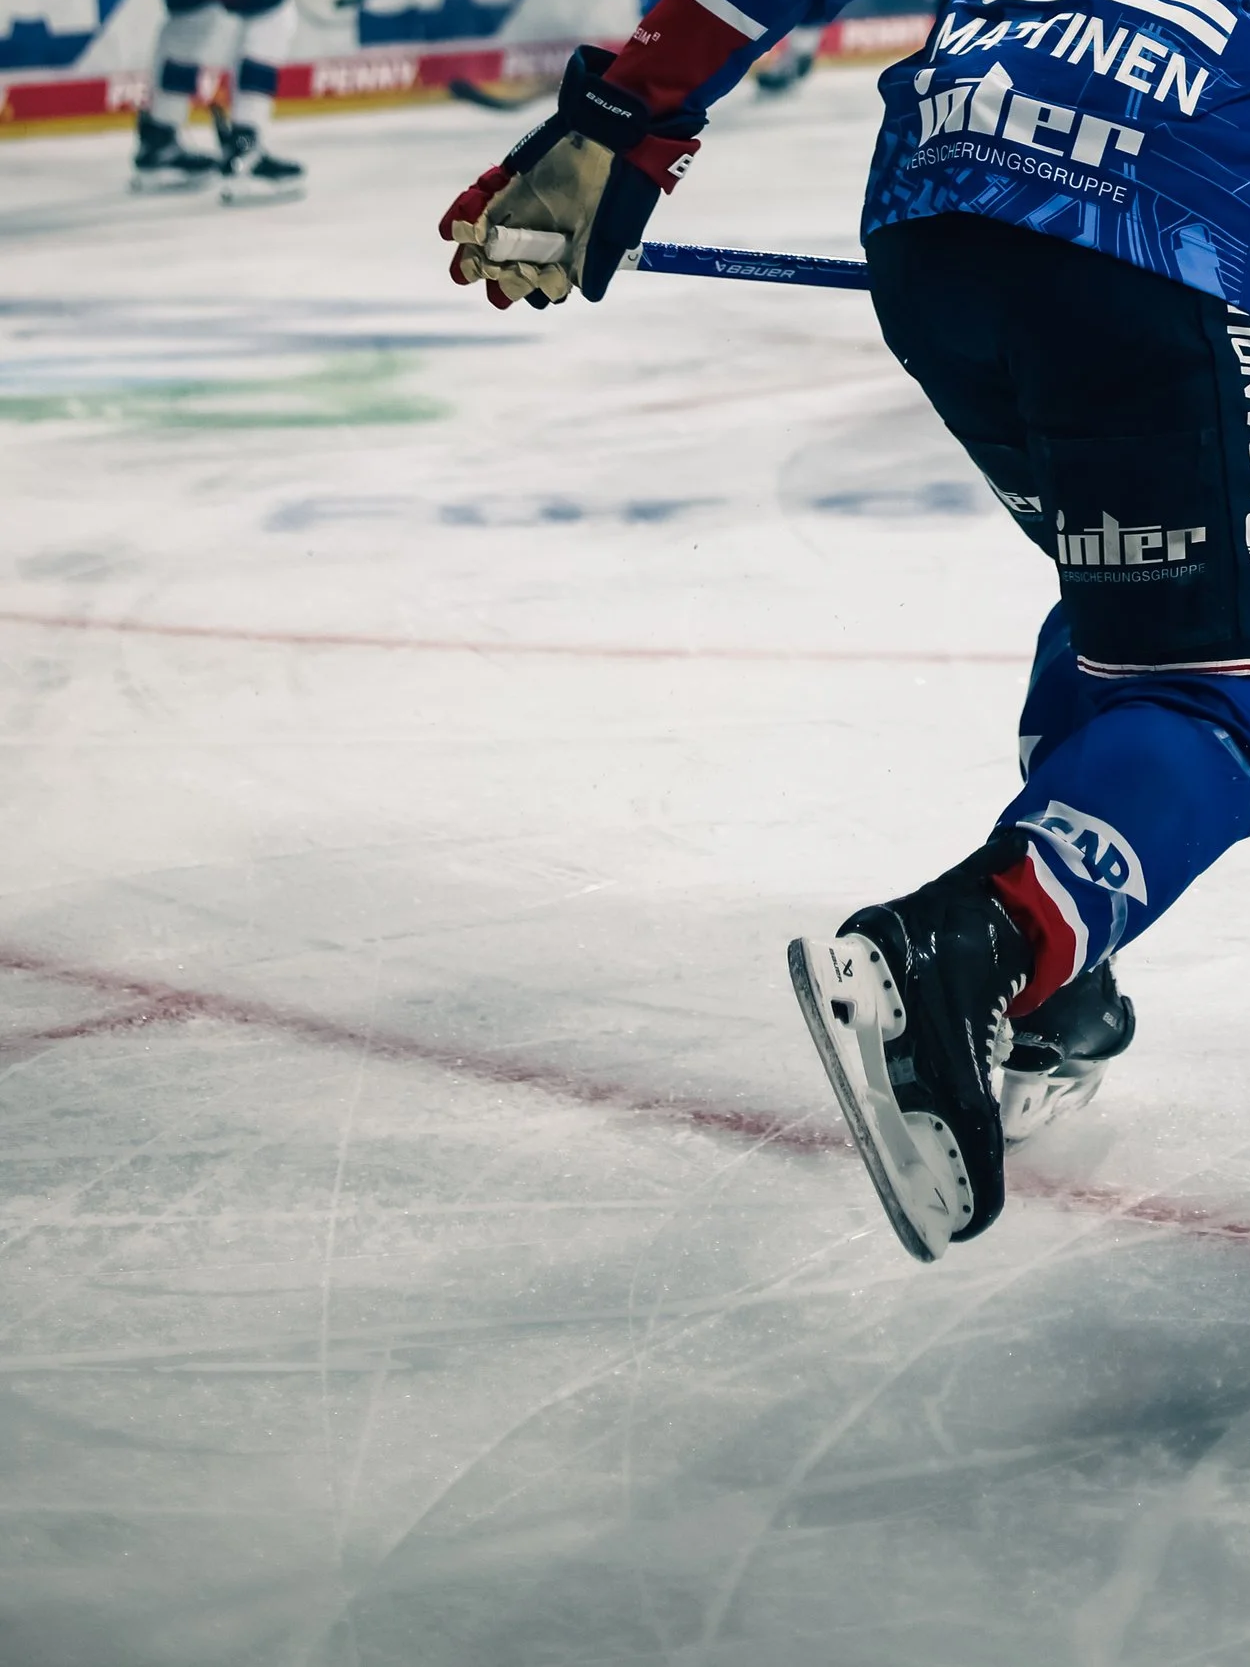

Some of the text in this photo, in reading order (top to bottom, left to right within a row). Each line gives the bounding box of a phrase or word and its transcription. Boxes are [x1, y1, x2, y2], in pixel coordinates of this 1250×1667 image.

[310, 55, 420, 95] PENNY
[586, 91, 632, 119] BAUER
[914, 61, 1145, 167] inter
[726, 264, 796, 279] BAUER
[1056, 509, 1207, 566] inter
[1062, 562, 1206, 583] ERSICHERUNGSGRUPPE
[829, 947, 843, 983] BAUER
